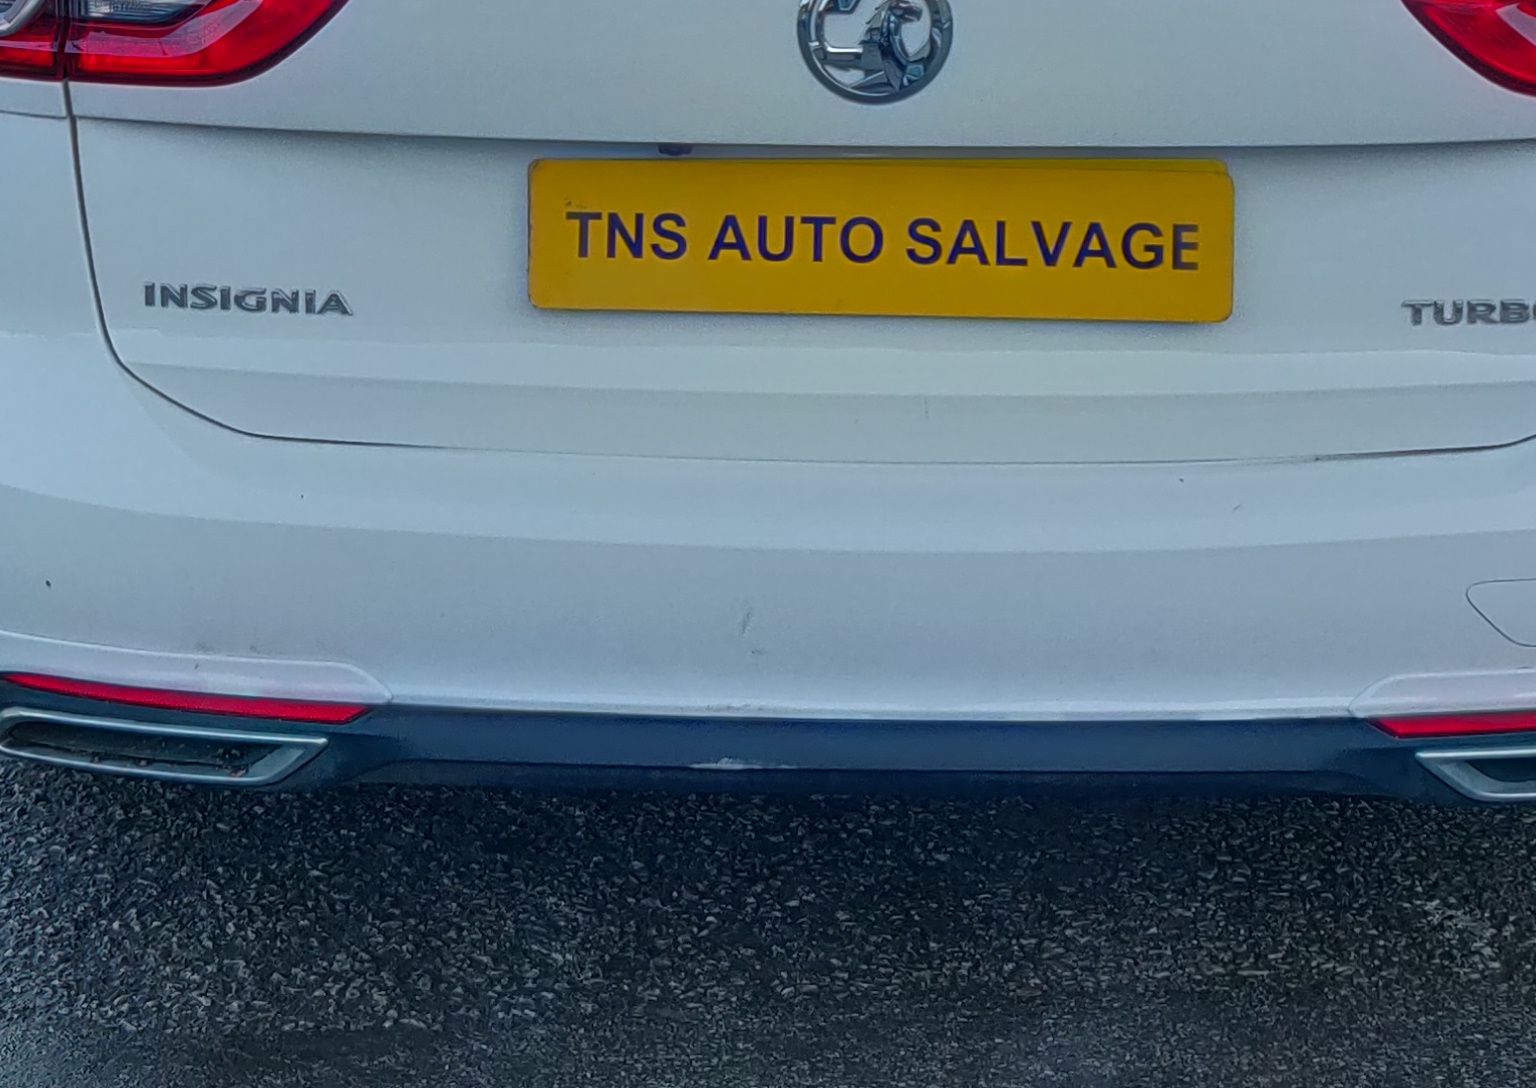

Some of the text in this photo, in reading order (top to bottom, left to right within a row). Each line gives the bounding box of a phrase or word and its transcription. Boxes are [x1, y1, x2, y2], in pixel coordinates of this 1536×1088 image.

[565, 210, 1200, 271] TNS AUTO SALVAGE
[143, 282, 353, 316] INSIGNIA
